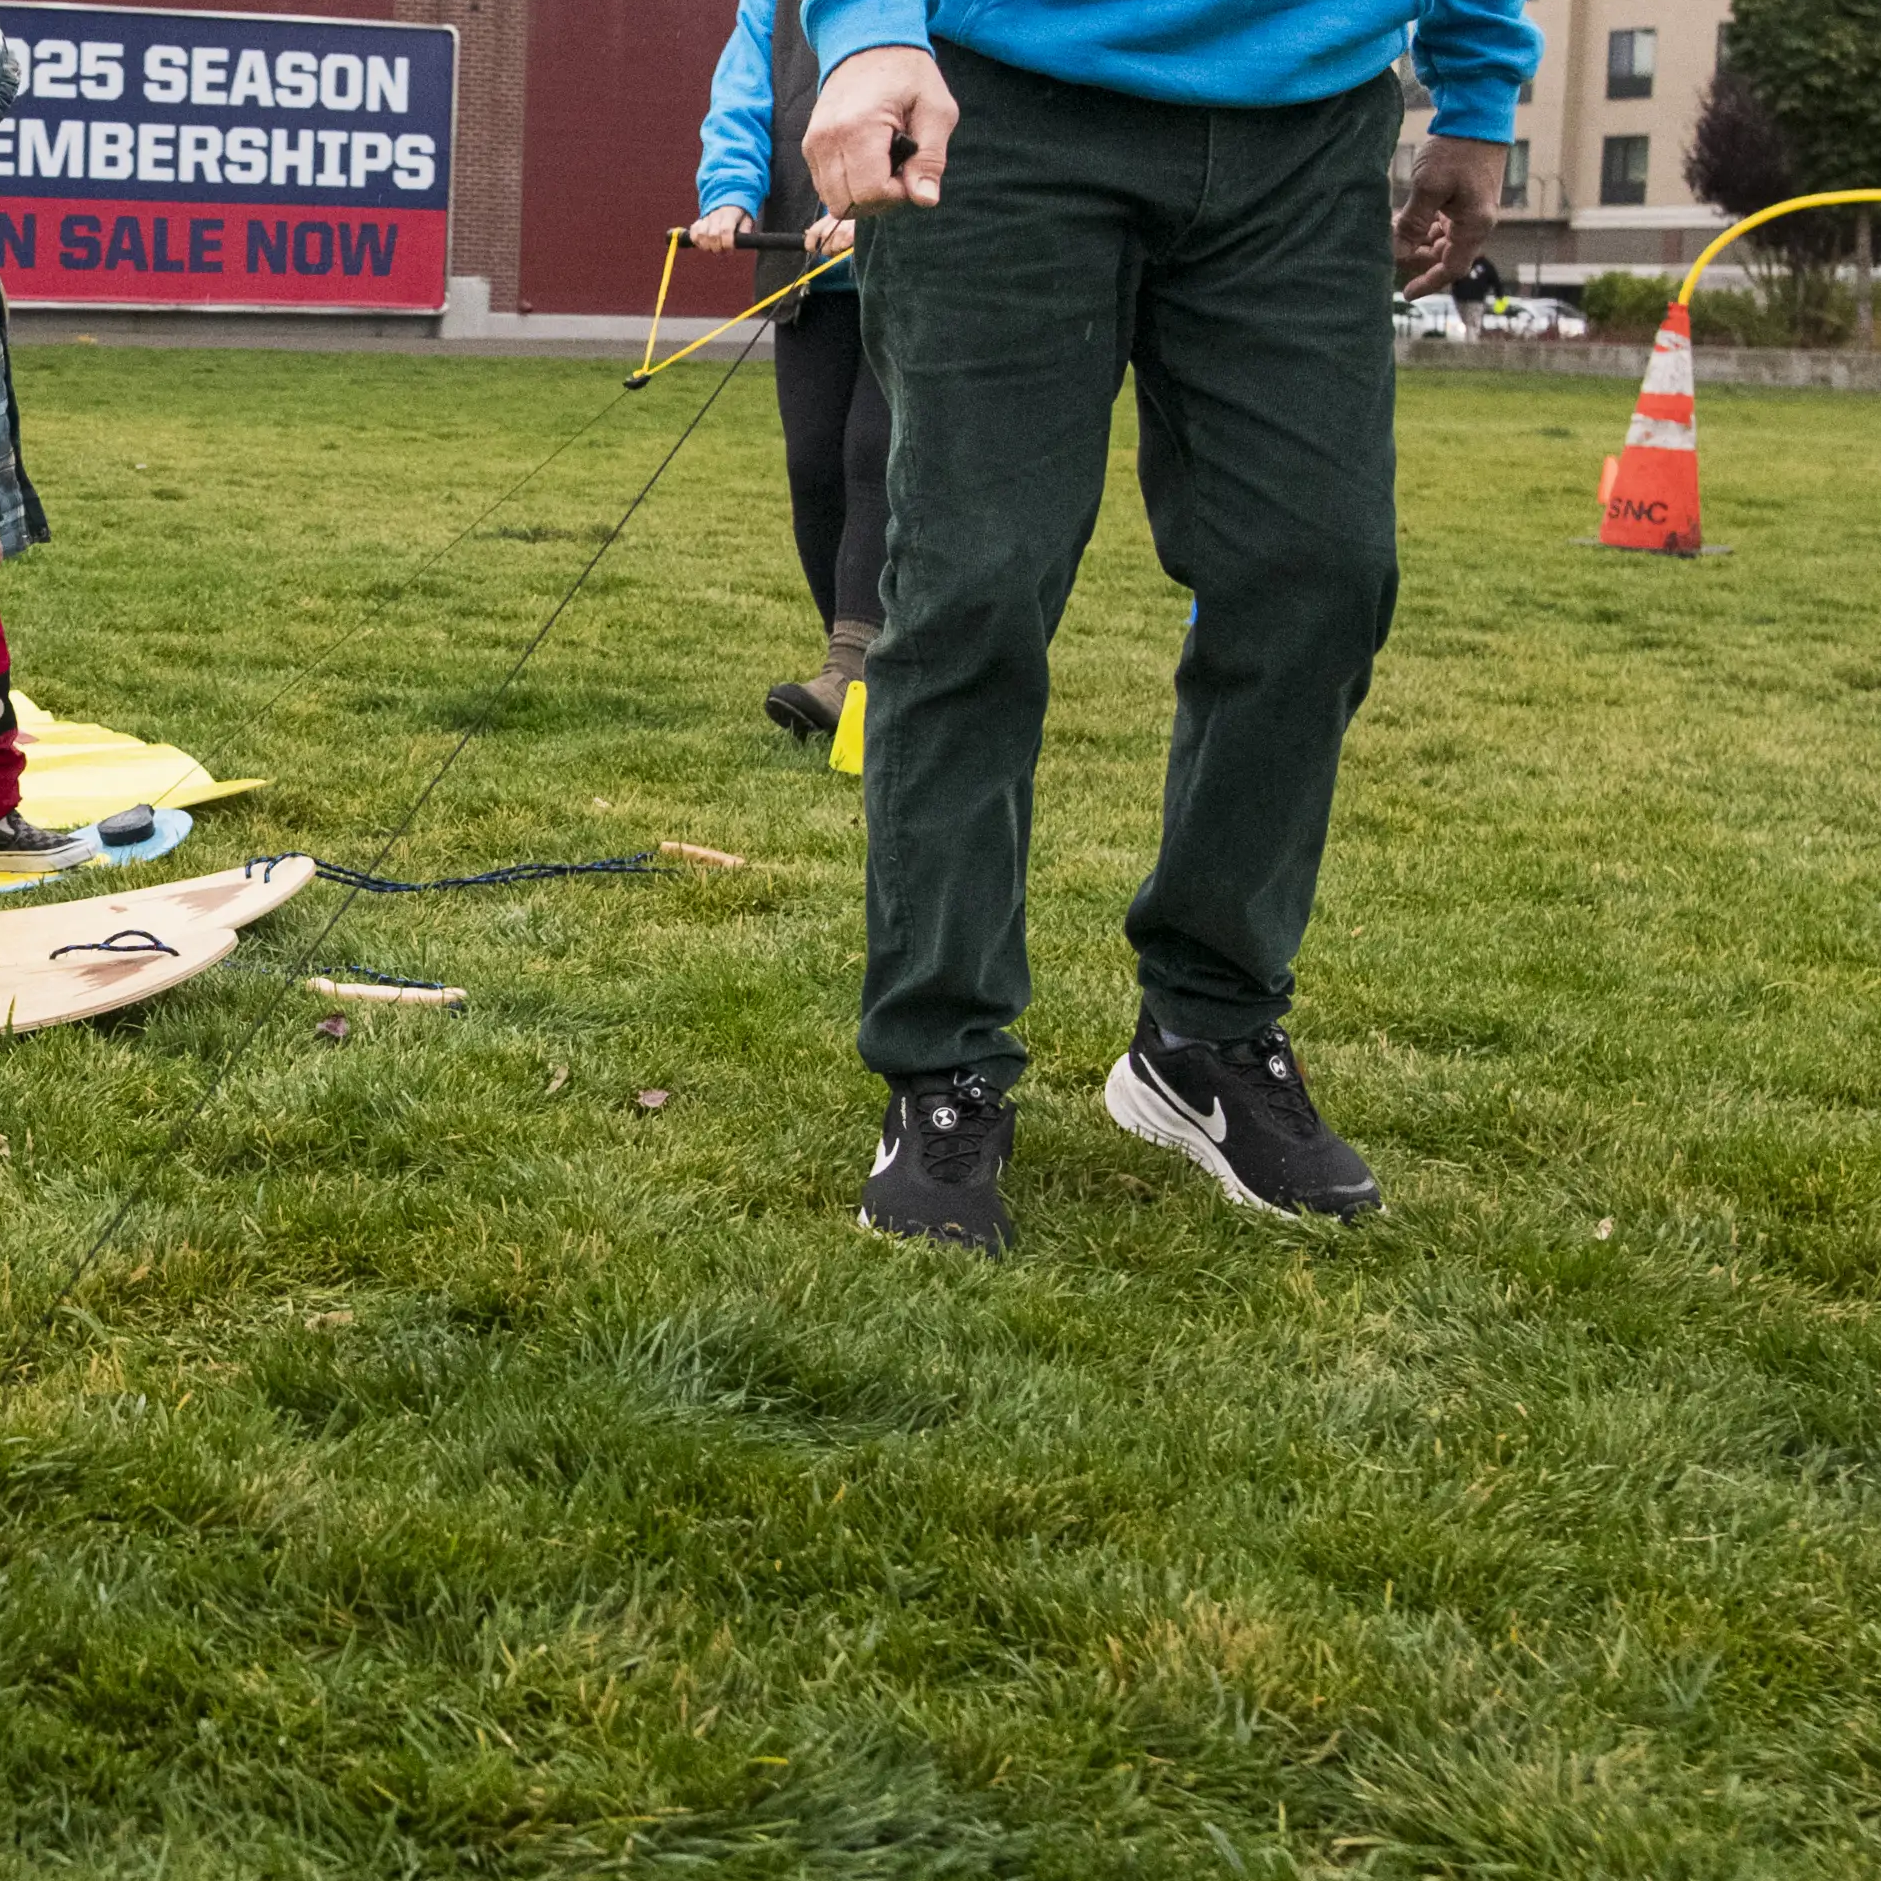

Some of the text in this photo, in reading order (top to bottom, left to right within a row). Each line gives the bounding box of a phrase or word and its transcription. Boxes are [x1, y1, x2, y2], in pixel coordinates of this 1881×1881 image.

[143, 44, 411, 116] SEASON
[59, 214, 224, 274] SALE
[246, 219, 399, 278] NOW
